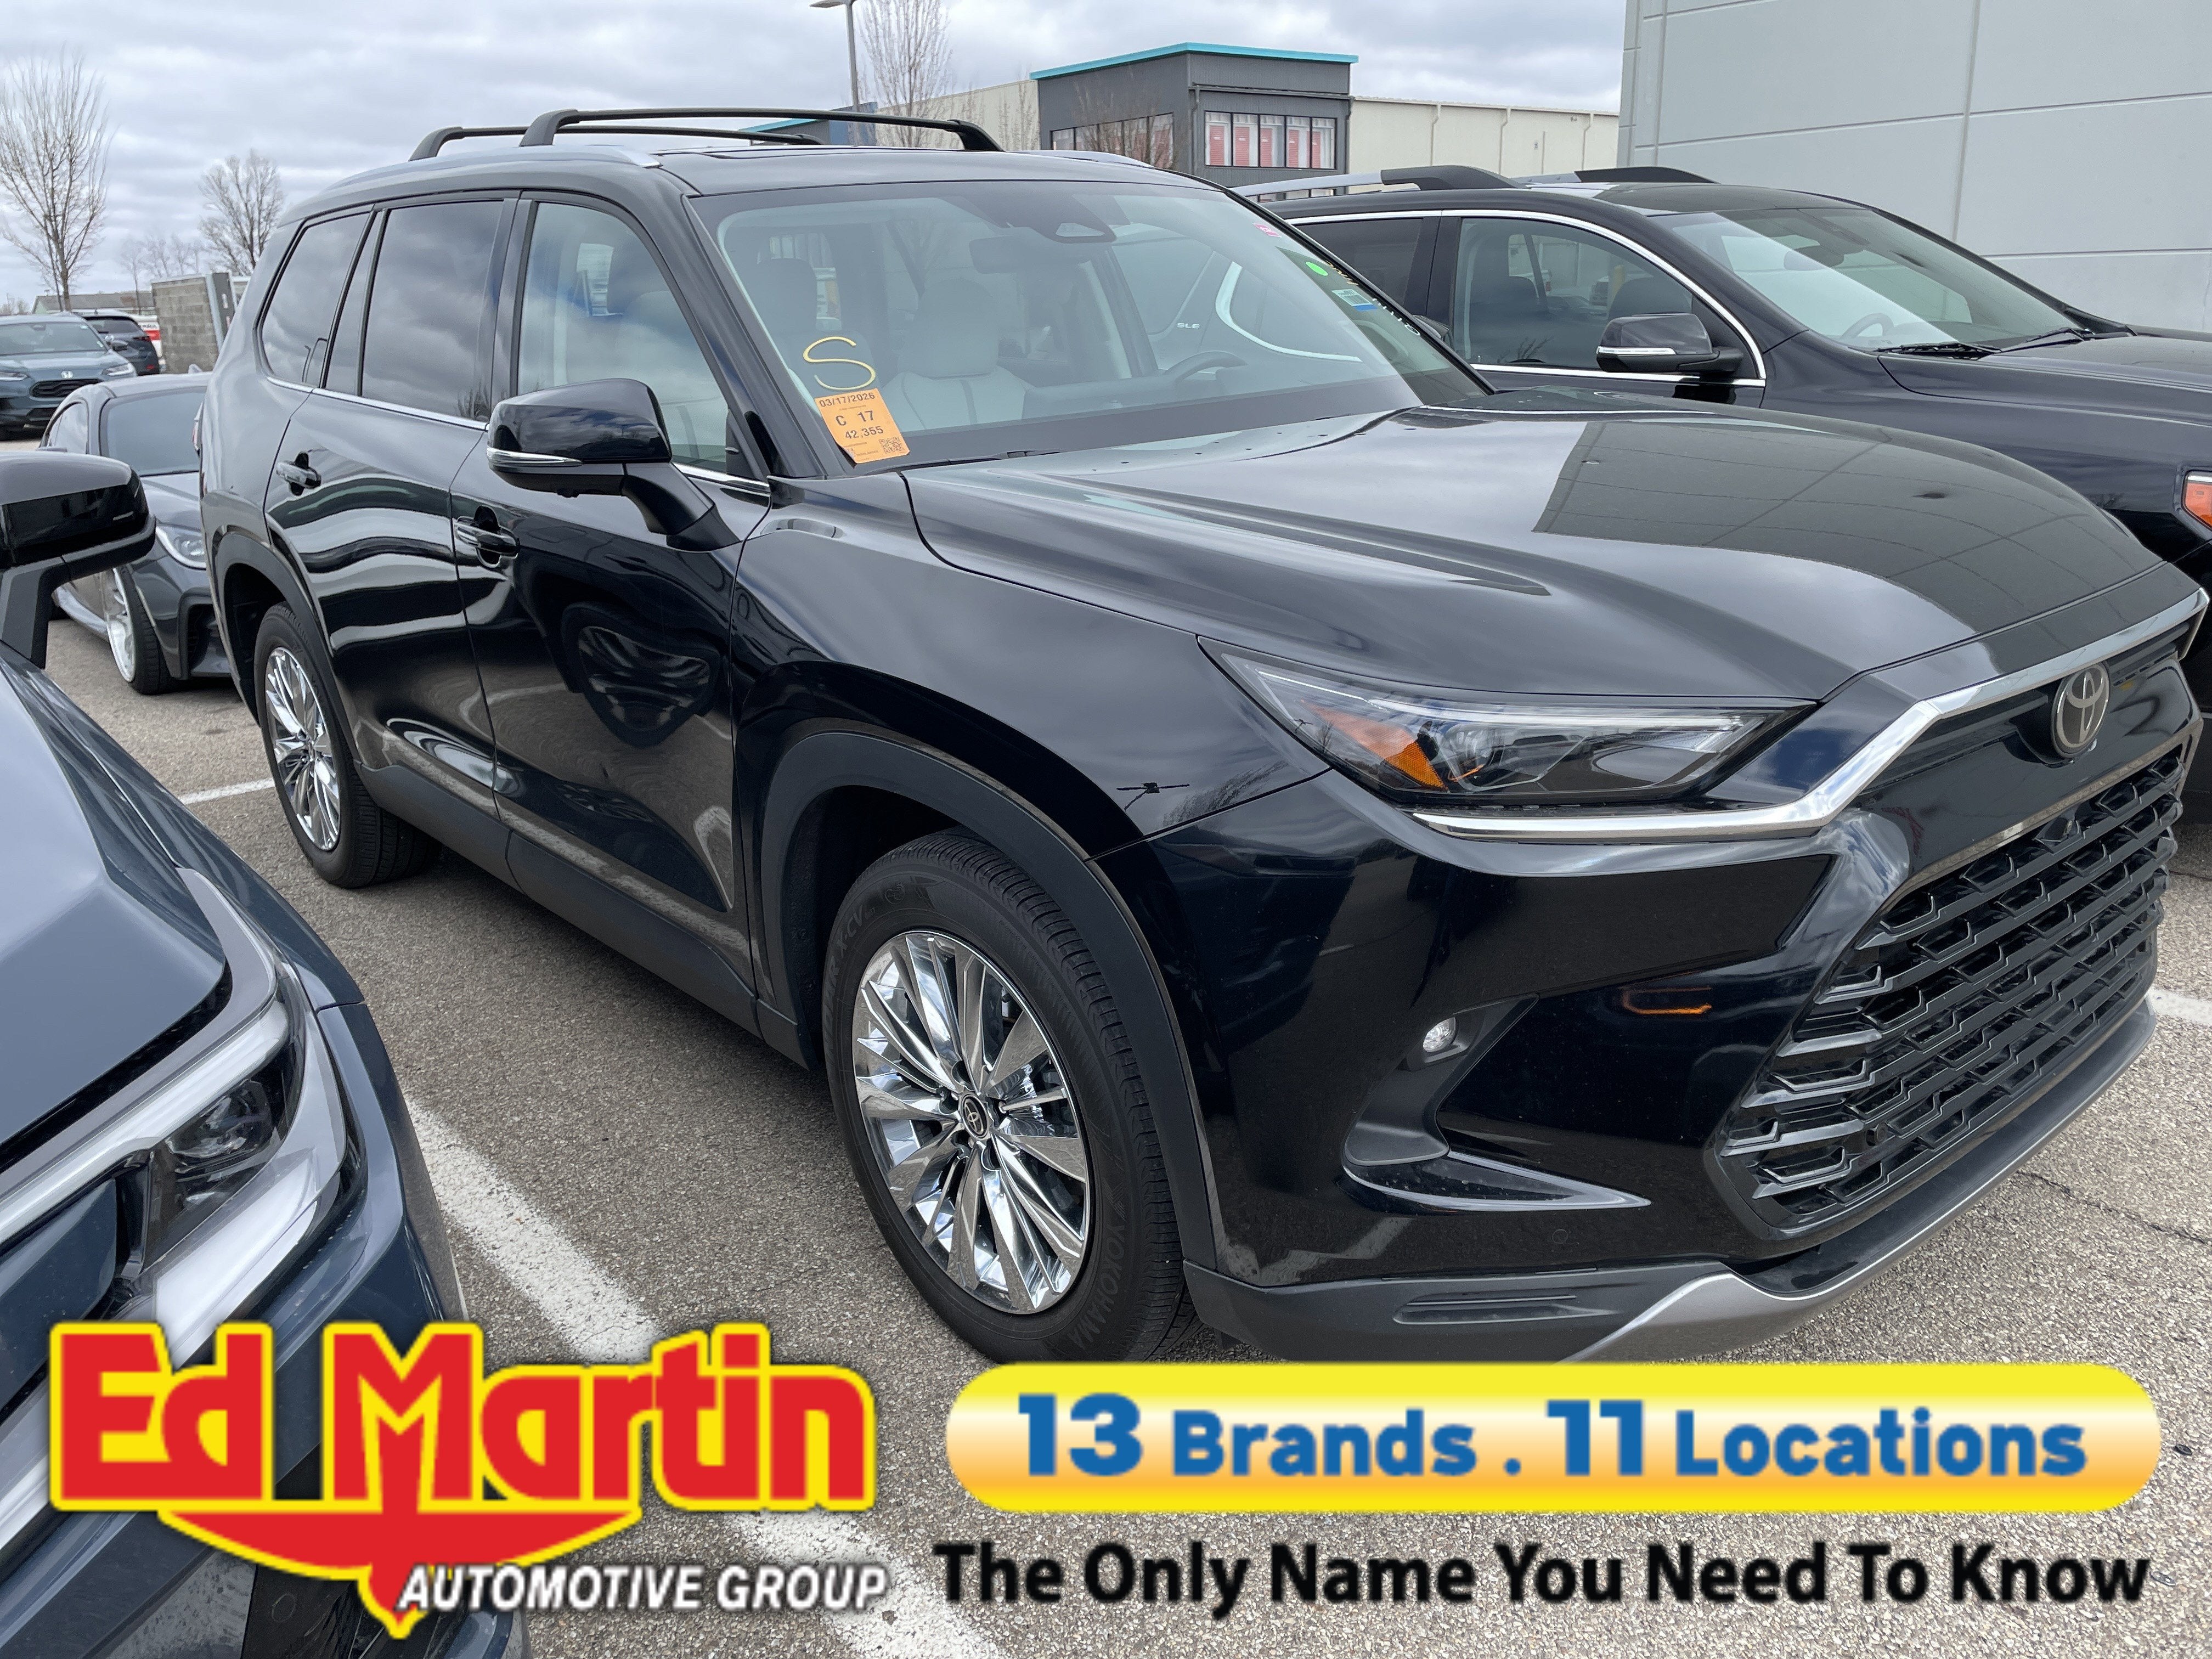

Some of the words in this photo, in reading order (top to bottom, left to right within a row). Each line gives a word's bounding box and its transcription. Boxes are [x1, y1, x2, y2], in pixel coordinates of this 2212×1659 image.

[803, 336, 876, 390] S
[819, 392, 876, 407] 03/17/2026
[836, 415, 847, 426] C
[857, 410, 873, 422] 17
[845, 426, 883, 439] 42,355
[1067, 1223, 1125, 1351] YOKOHAMA
